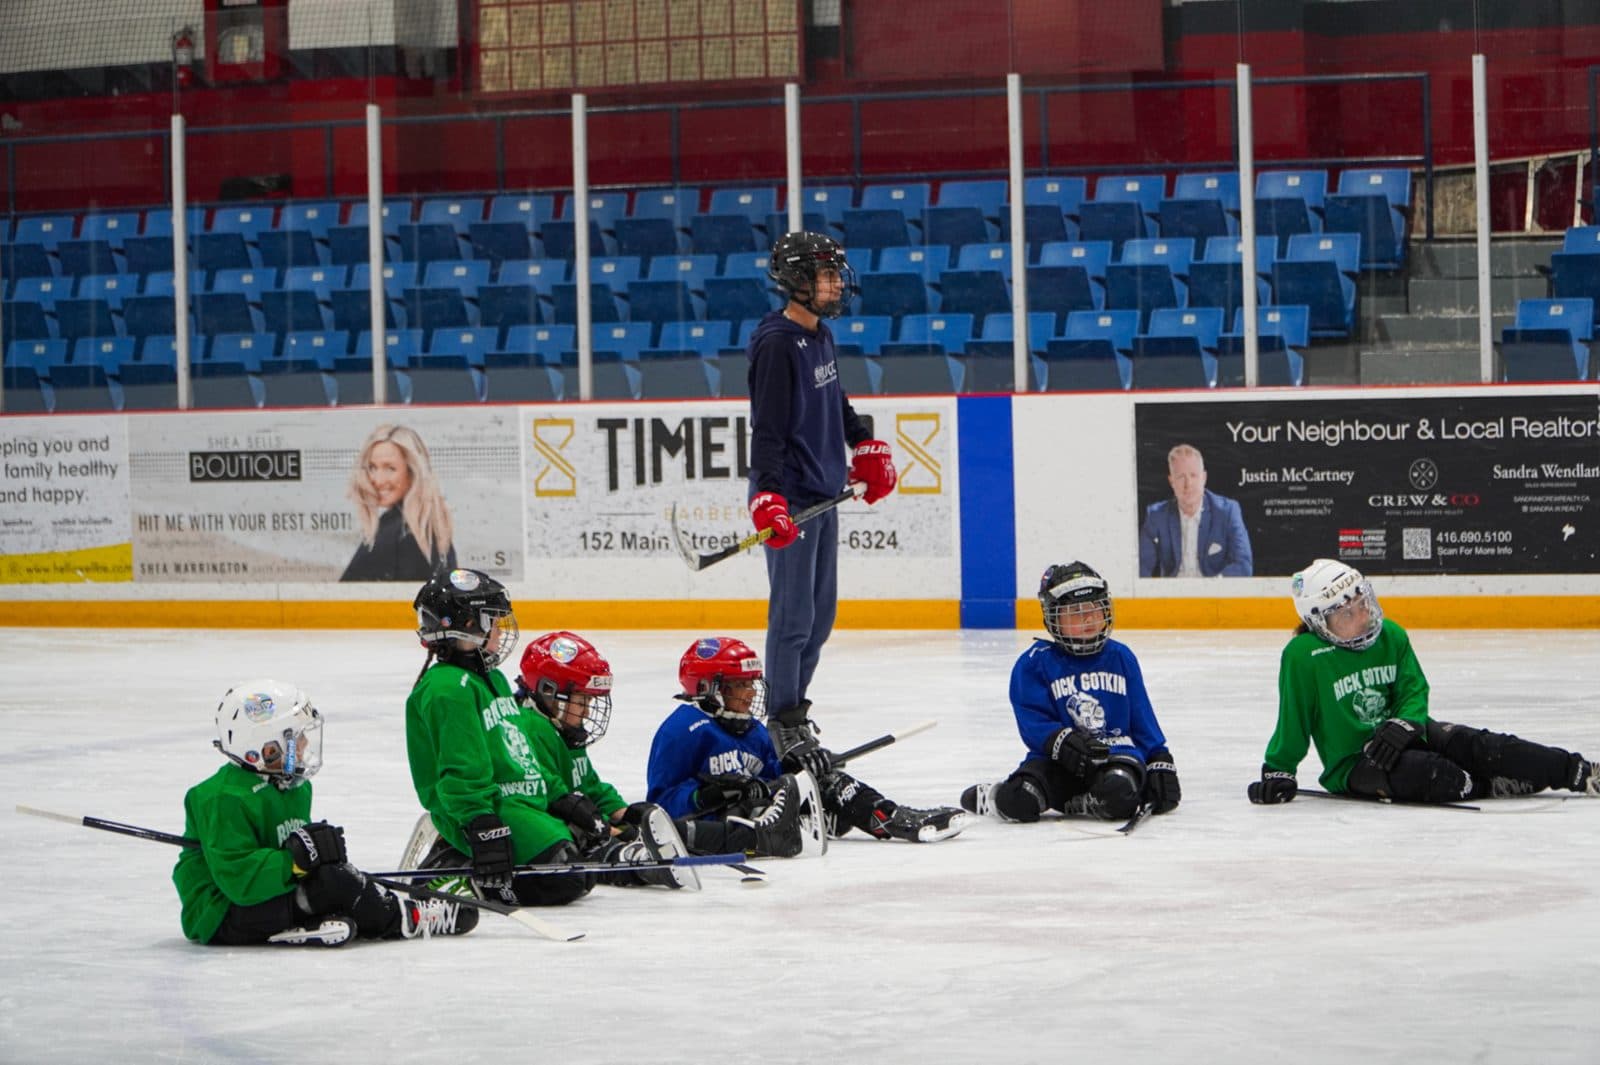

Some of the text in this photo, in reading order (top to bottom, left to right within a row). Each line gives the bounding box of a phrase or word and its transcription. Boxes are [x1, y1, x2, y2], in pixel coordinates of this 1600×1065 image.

[1226, 420, 1281, 443] Your
[1287, 419, 1410, 447] Neighbour
[1416, 418, 1435, 440] &
[1441, 417, 1504, 440] Local
[0, 435, 109, 458] ping you and
[597, 416, 750, 492] TIMEL
[4, 460, 118, 480] family healthy
[192, 453, 299, 479] BOUTIQUE
[1238, 463, 1600, 487] Justin McCartney Sandra Wendlan
[32, 486, 89, 505] happy.
[1368, 494, 1428, 508] CREW
[1431, 493, 1448, 507] &
[138, 512, 352, 532] HIT ME WITH YOUR BEST SHOT!
[580, 531, 614, 551] 152
[621, 531, 669, 551] Main
[1436, 530, 1513, 544] 416.690.5100
[1459, 545, 1473, 555] For
[1081, 671, 1127, 696] GOTKIN
[1333, 671, 1362, 700] RICK
[709, 749, 742, 776] RICK
